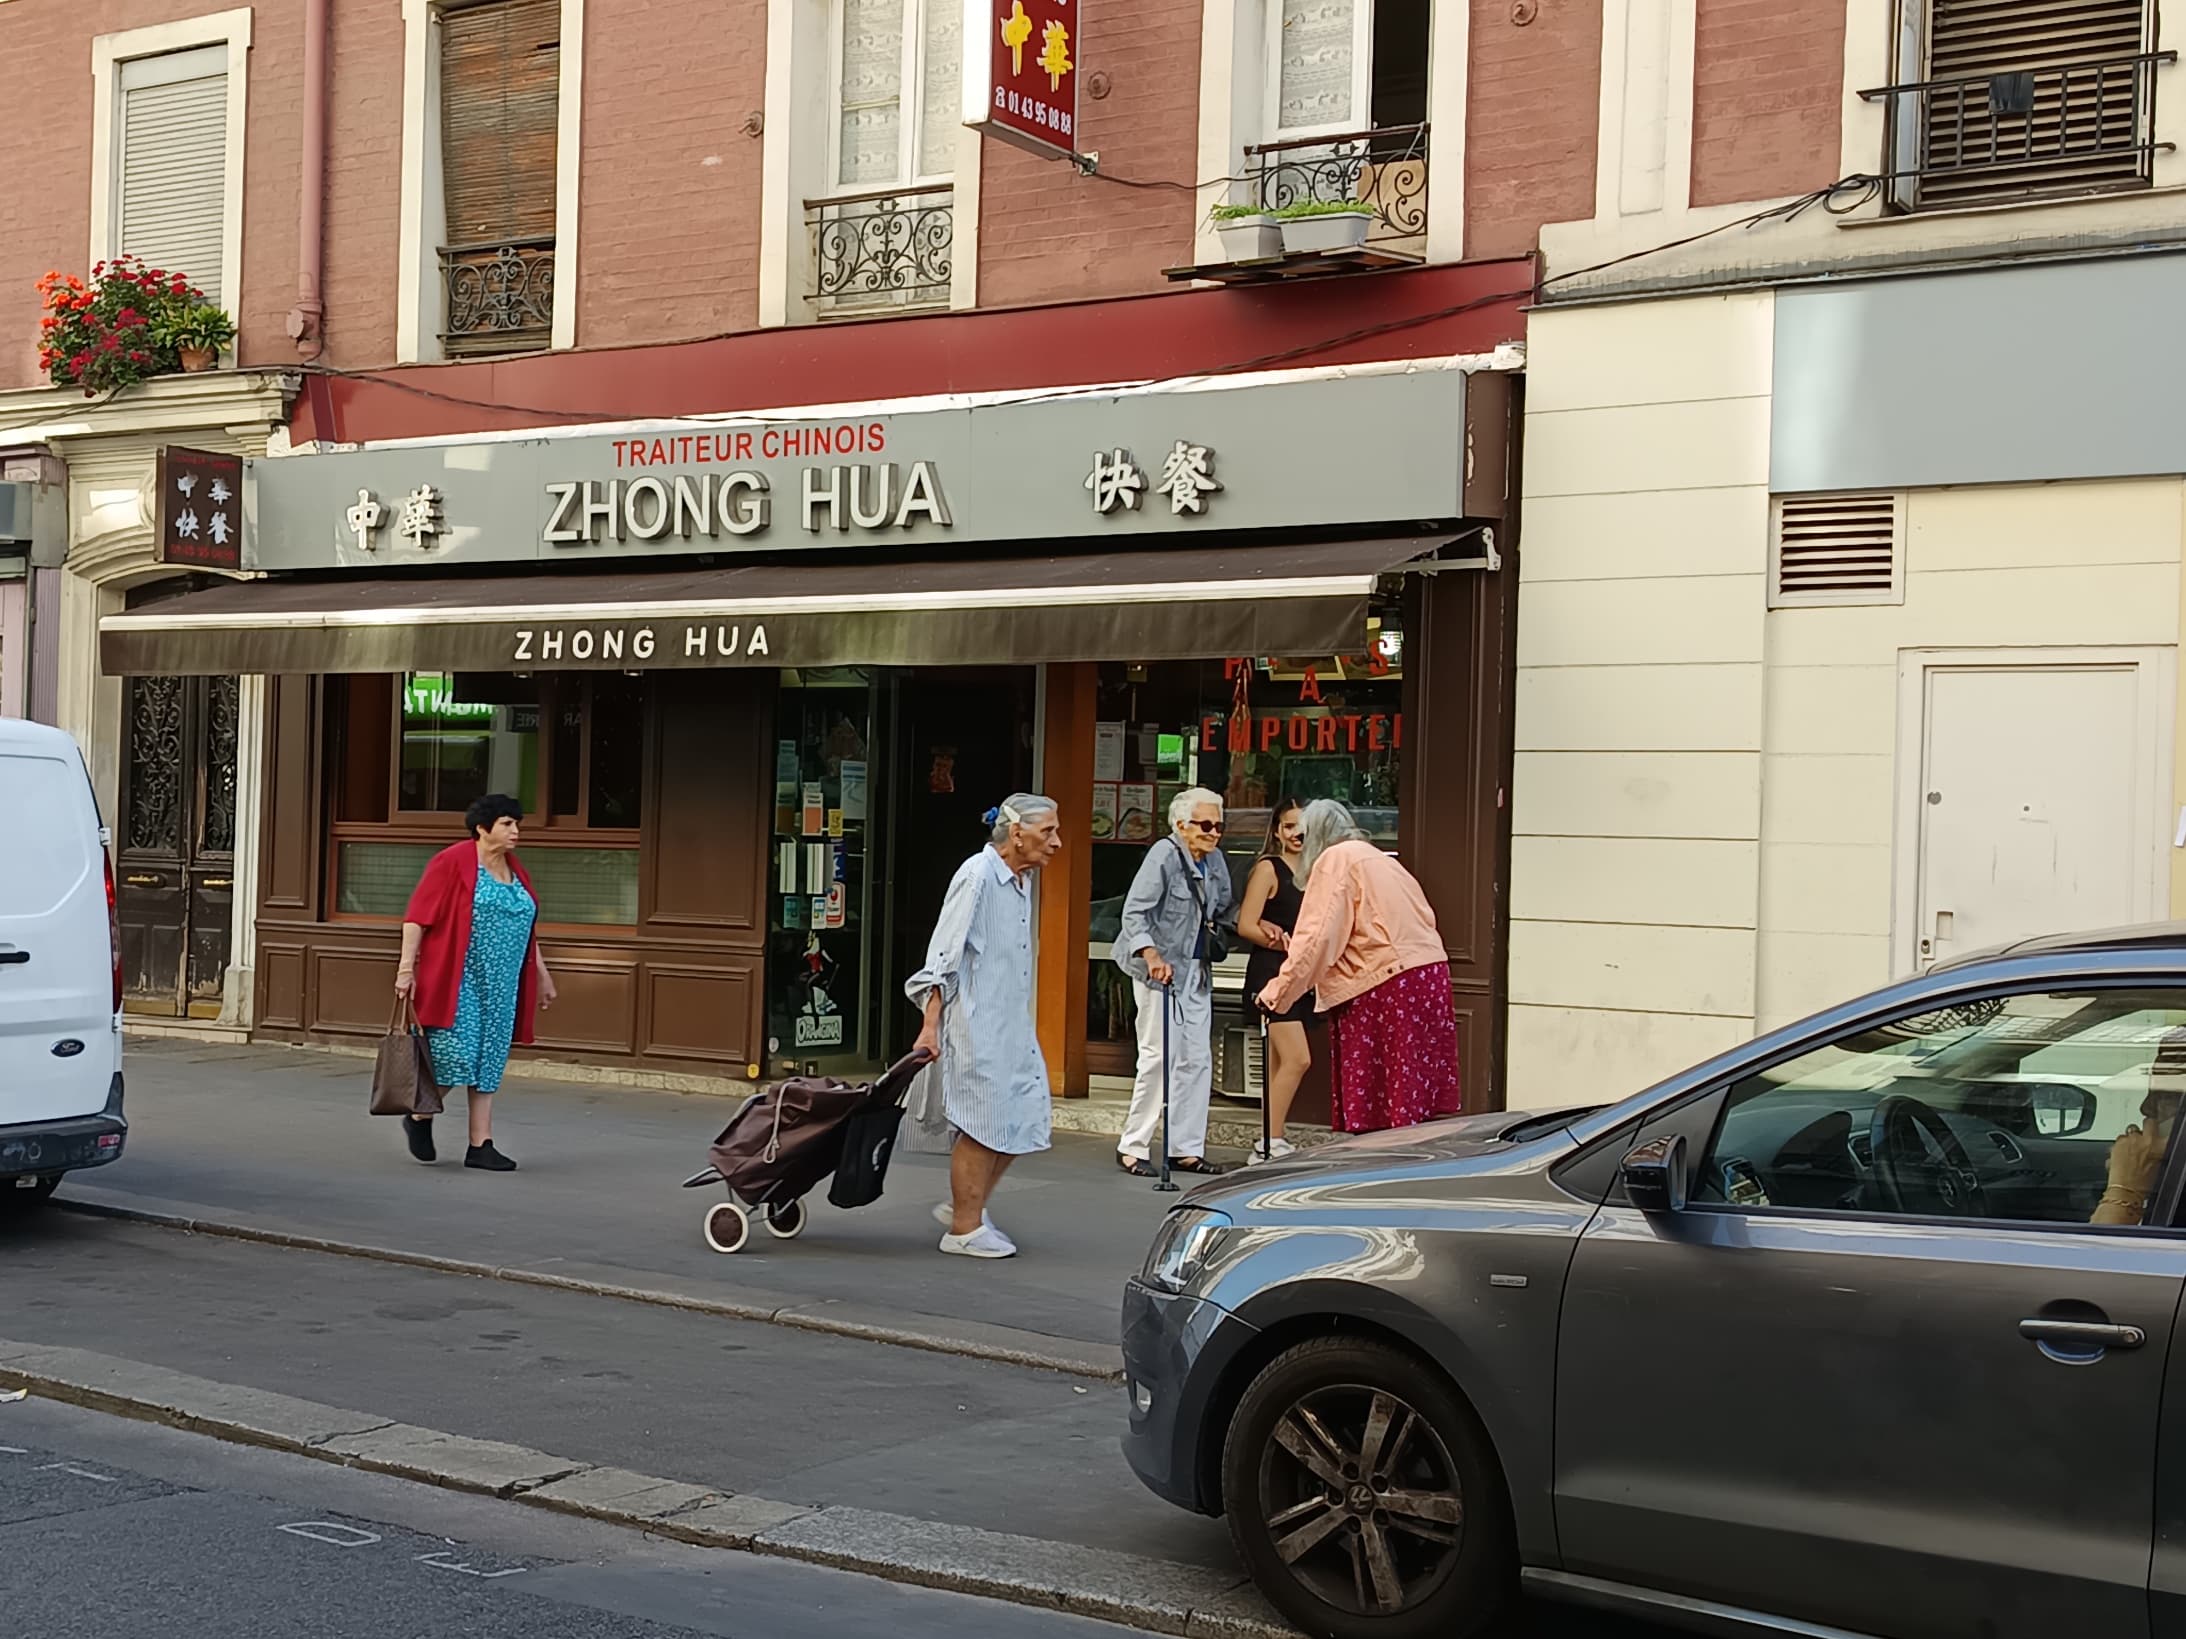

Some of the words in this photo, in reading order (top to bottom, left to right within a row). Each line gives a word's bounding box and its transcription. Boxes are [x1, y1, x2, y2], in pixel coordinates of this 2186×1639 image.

[1008, 90, 1019, 115] 01
[1021, 96, 1033, 120] 43
[1034, 101, 1047, 126] 95
[1048, 106, 1060, 131] 08
[1060, 111, 1072, 136] 88
[612, 433, 753, 467] TRAITEUR
[762, 423, 885, 458] CHINOIS
[1083, 440, 1222, 516] 快餐
[345, 484, 440, 551] 中華
[543, 470, 769, 546] ZHONG
[801, 461, 951, 532] HUA
[514, 629, 656, 660] ZHONG
[685, 624, 770, 656] HUA
[1299, 664, 1320, 702] A
